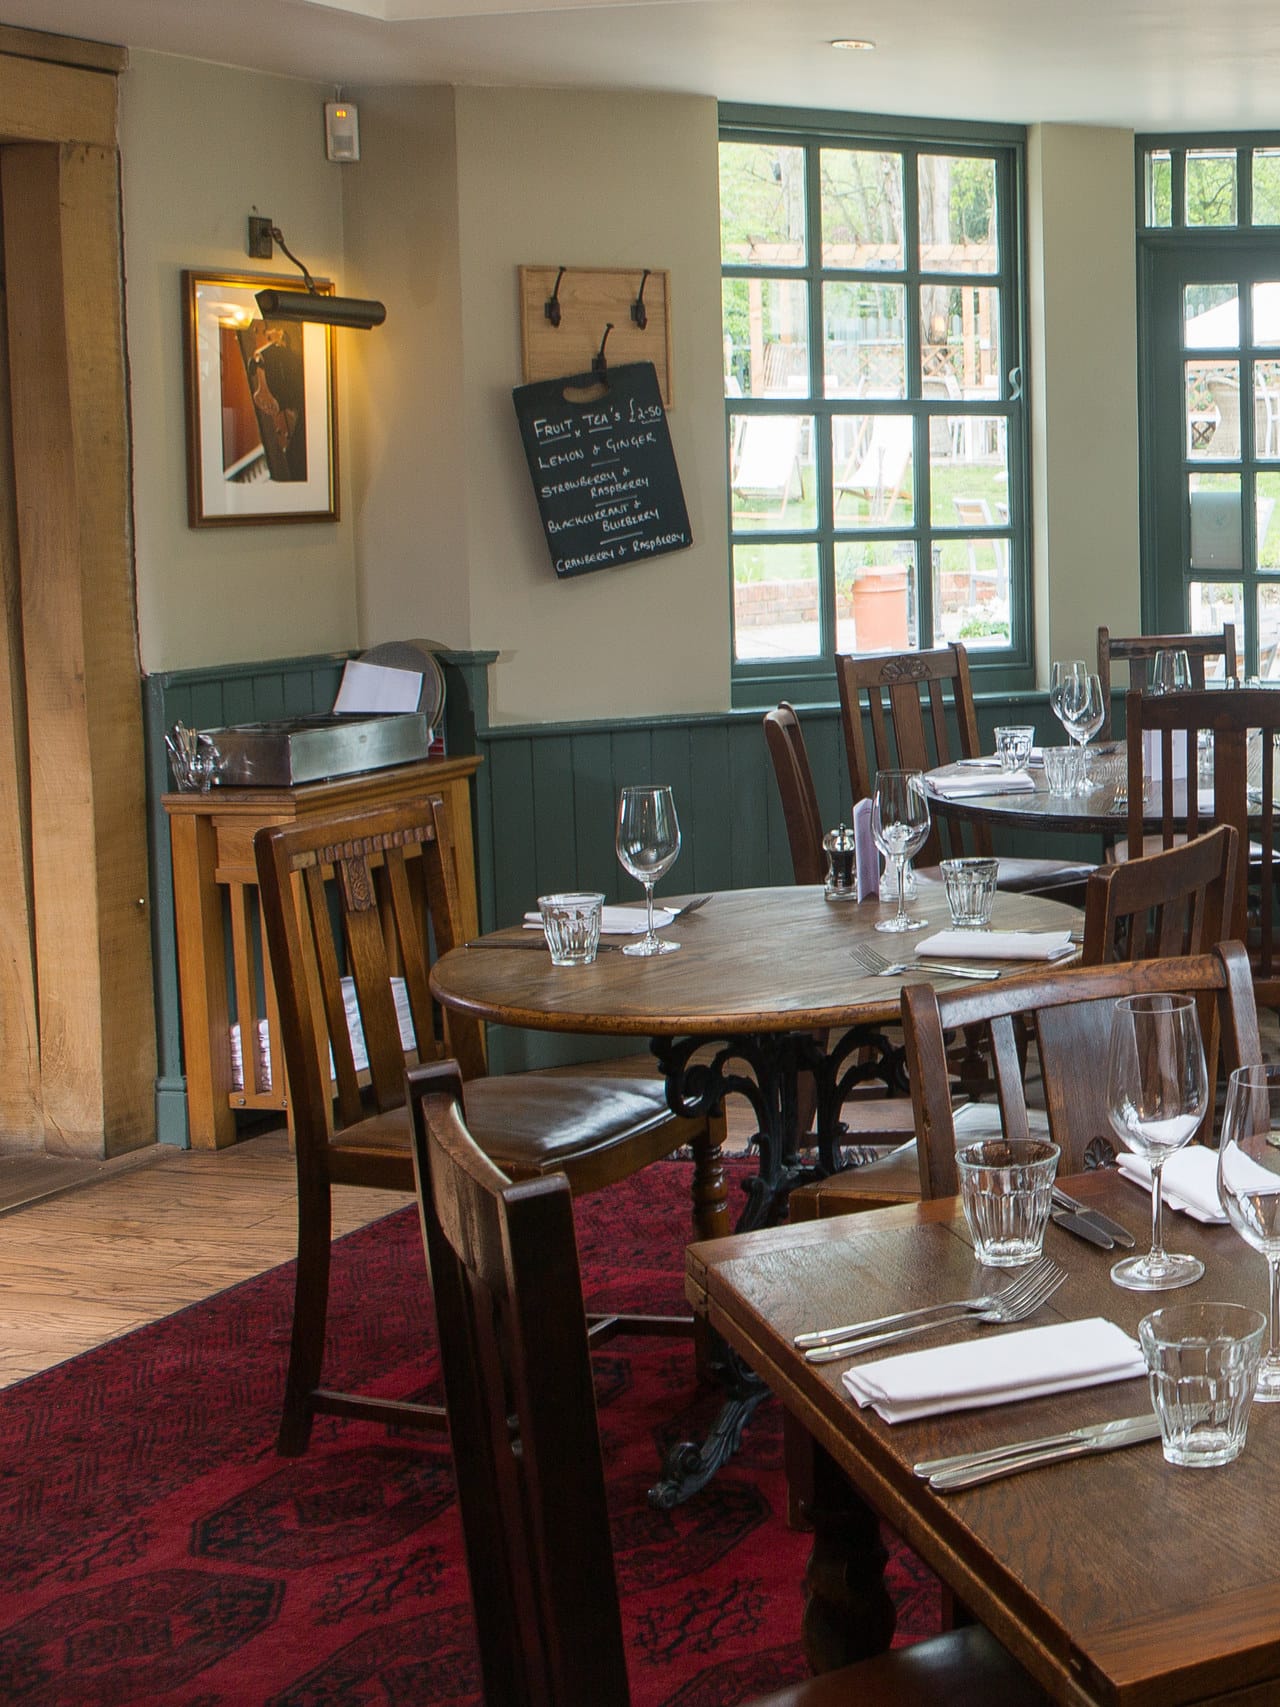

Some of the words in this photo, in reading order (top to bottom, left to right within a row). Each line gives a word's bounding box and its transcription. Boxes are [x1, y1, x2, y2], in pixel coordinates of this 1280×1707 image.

[534, 419, 573, 438] FRUIT
[538, 450, 585, 469] LEMON
[606, 432, 657, 453] GINGER
[590, 477, 650, 499] RASPBERRY
[547, 504, 629, 533] BLACKCURRANT
[602, 508, 660, 532] BLUEBERRY
[556, 549, 615, 572] CRANBERRY
[632, 532, 685, 552] RASPBERRY
